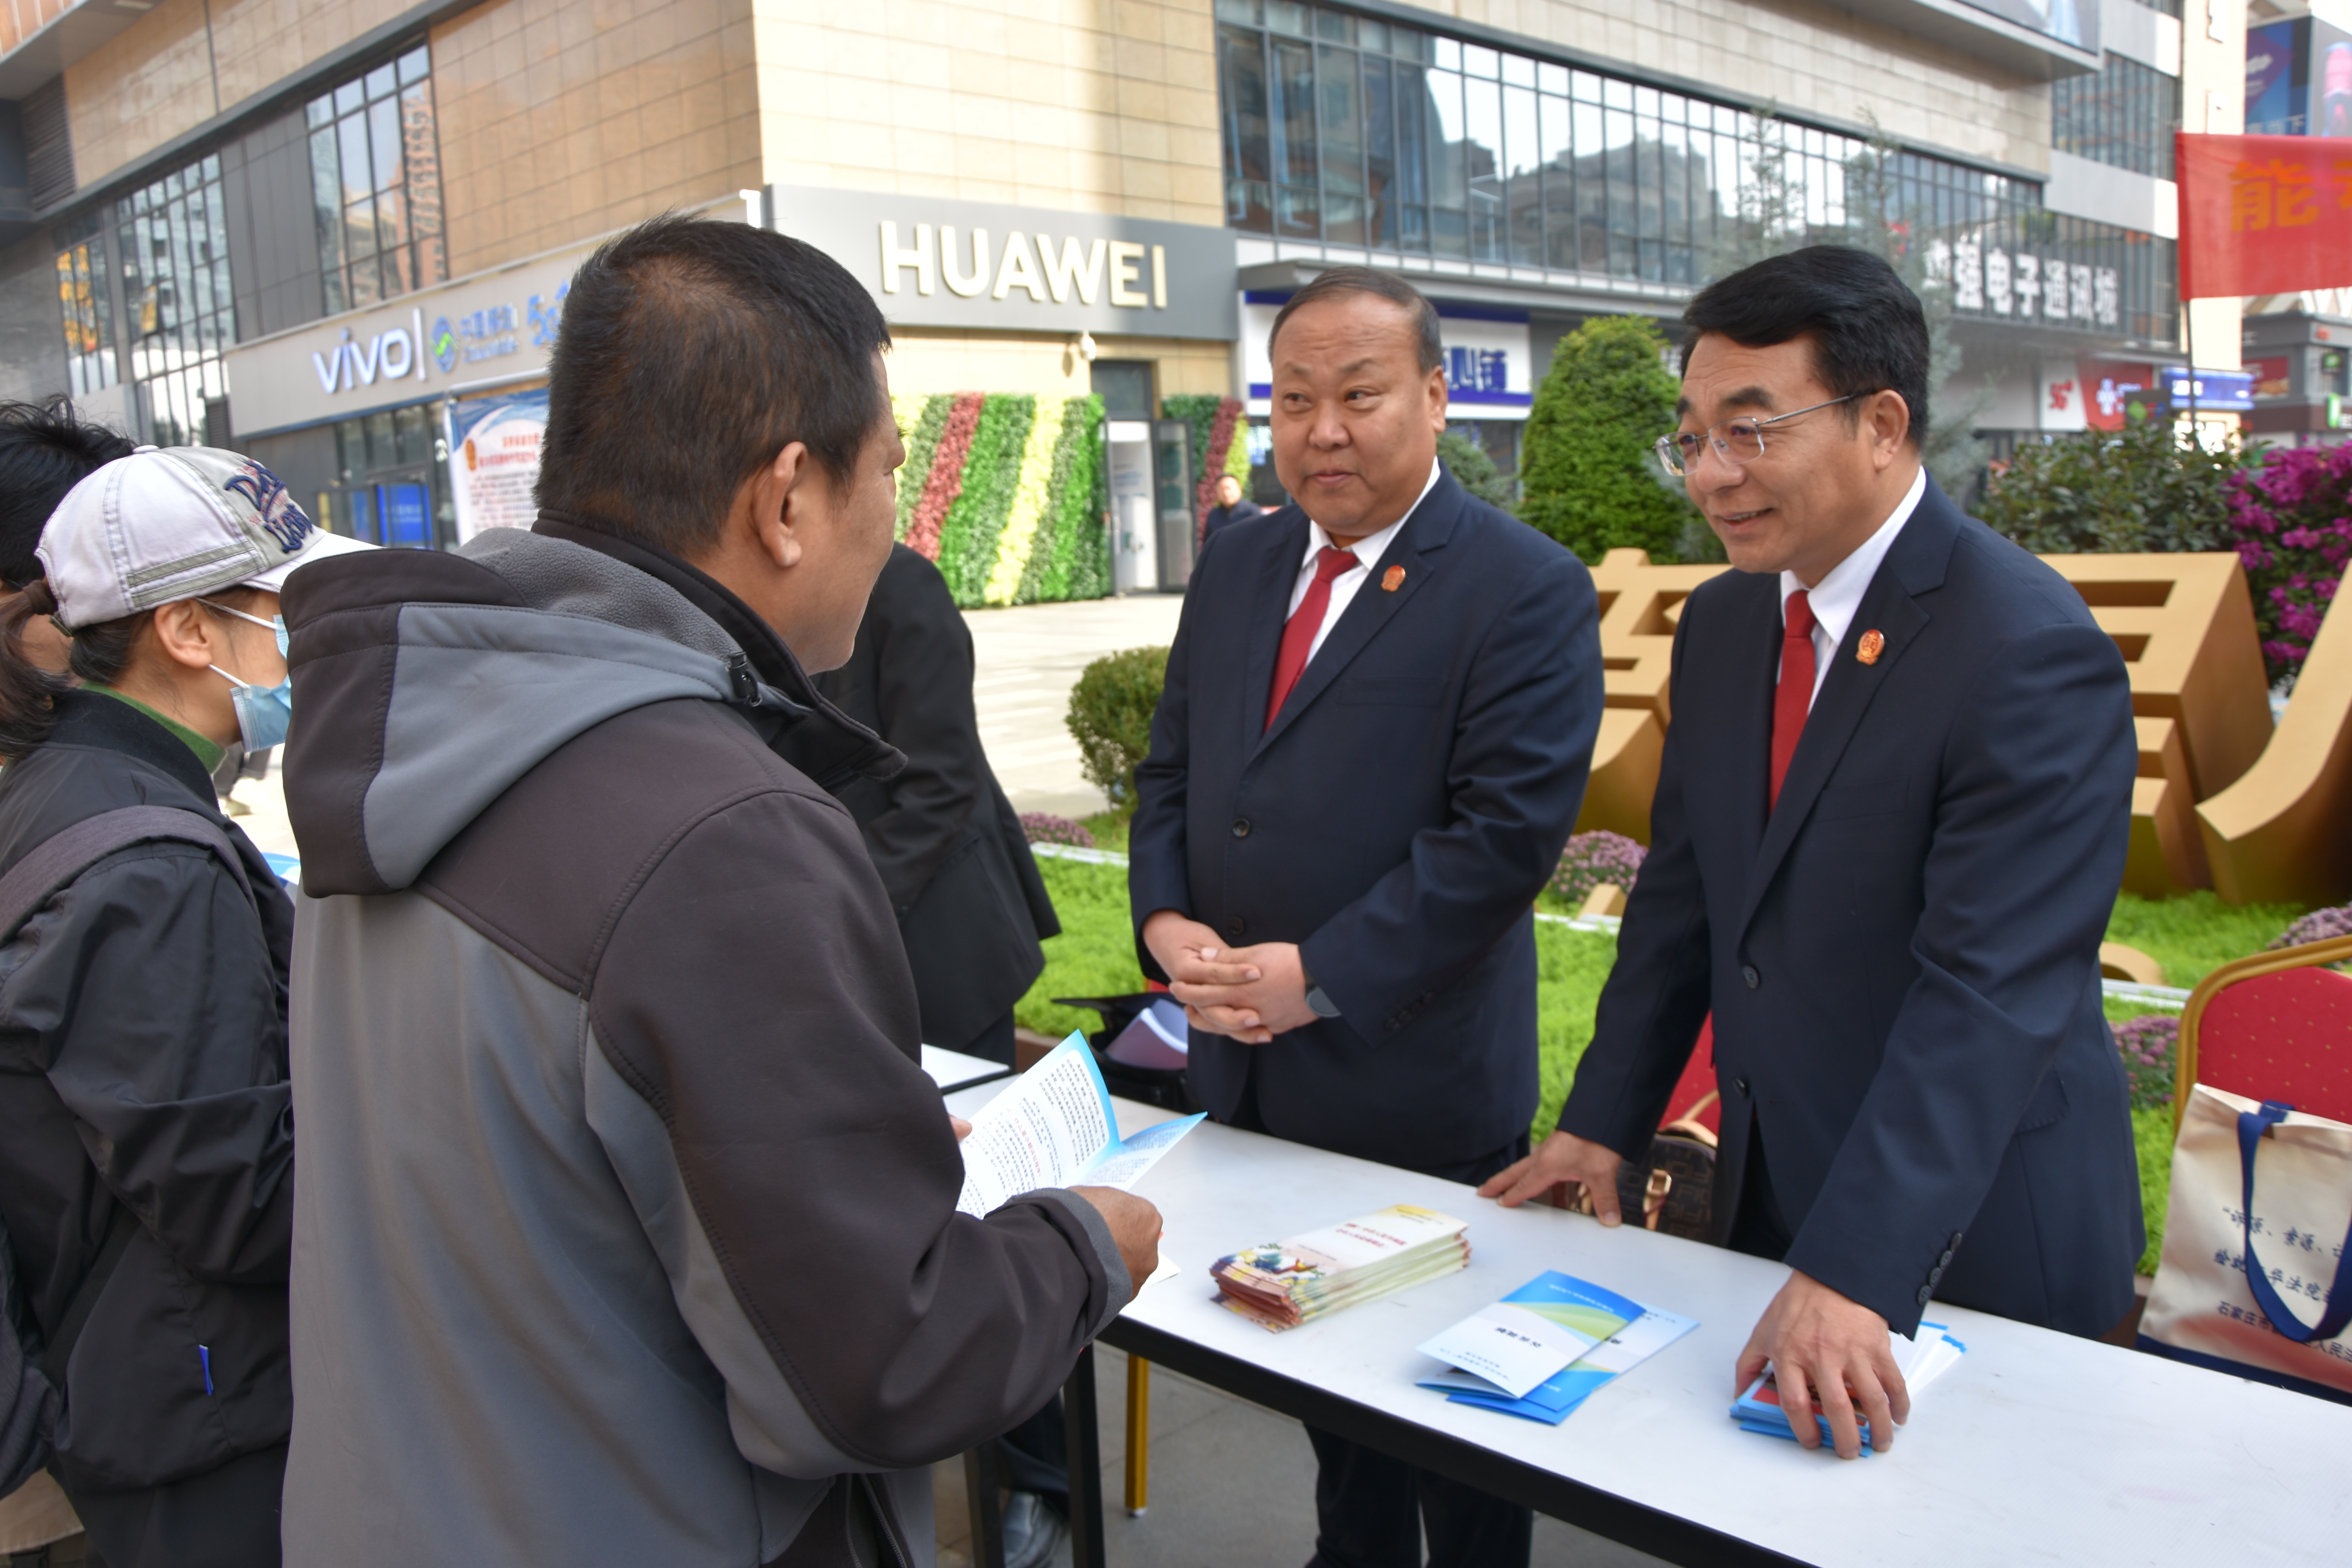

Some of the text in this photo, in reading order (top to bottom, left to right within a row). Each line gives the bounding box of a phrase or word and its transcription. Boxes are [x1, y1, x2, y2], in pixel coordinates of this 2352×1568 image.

[2229, 159, 2352, 231] 能
[880, 220, 1167, 308] HUAWEI
[312, 328, 411, 394] vivo
